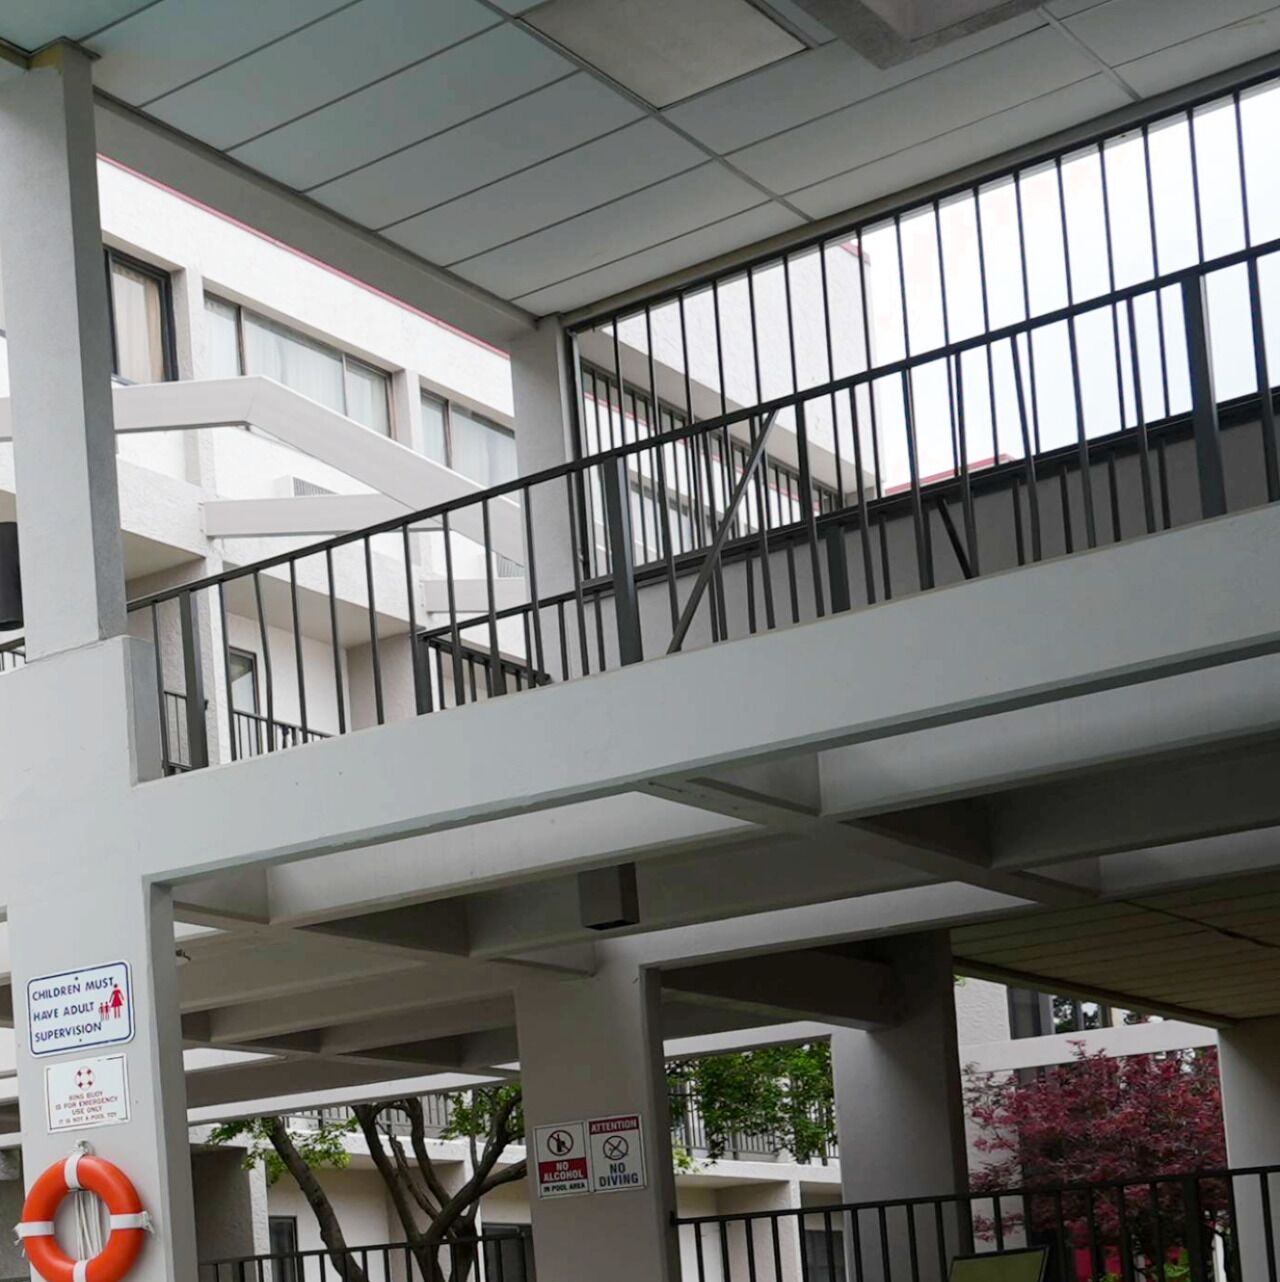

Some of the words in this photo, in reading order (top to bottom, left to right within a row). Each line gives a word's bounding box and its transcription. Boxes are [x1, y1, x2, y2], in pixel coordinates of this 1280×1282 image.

[32, 983, 80, 1001] CHILDREN
[85, 977, 114, 991] MUST
[33, 1008, 59, 1021] HAVE
[63, 1002, 94, 1016] ADULT
[35, 1022, 102, 1042] SUPERVISION
[79, 1096, 118, 1107] EMERGENCY
[591, 1118, 637, 1132] ATTENTION
[556, 1161, 569, 1170] NO
[609, 1162, 625, 1173] NO
[543, 1170, 584, 1181] ALCOHOL
[600, 1173, 638, 1187] DIVING
[552, 1184, 567, 1192] POOL
